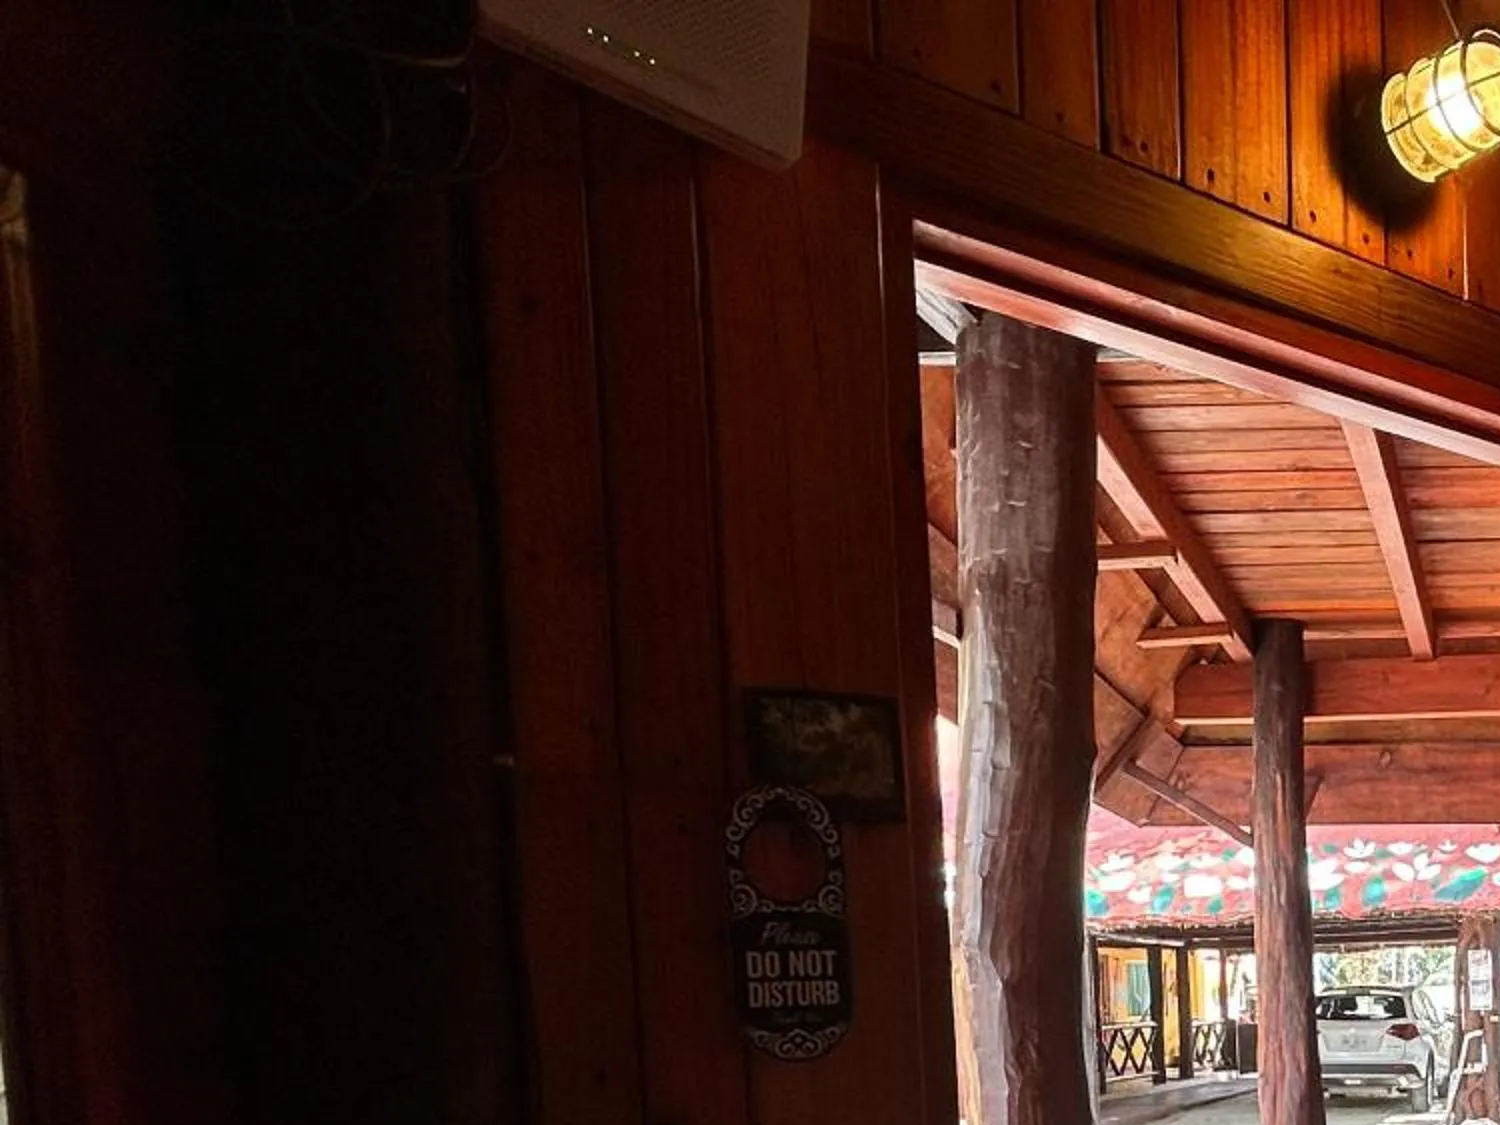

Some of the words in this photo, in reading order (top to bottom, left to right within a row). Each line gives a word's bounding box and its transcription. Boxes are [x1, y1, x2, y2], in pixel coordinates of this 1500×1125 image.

[746, 950, 781, 978] DO
[788, 949, 838, 977] NOT
[748, 980, 841, 1008] DISTURB
